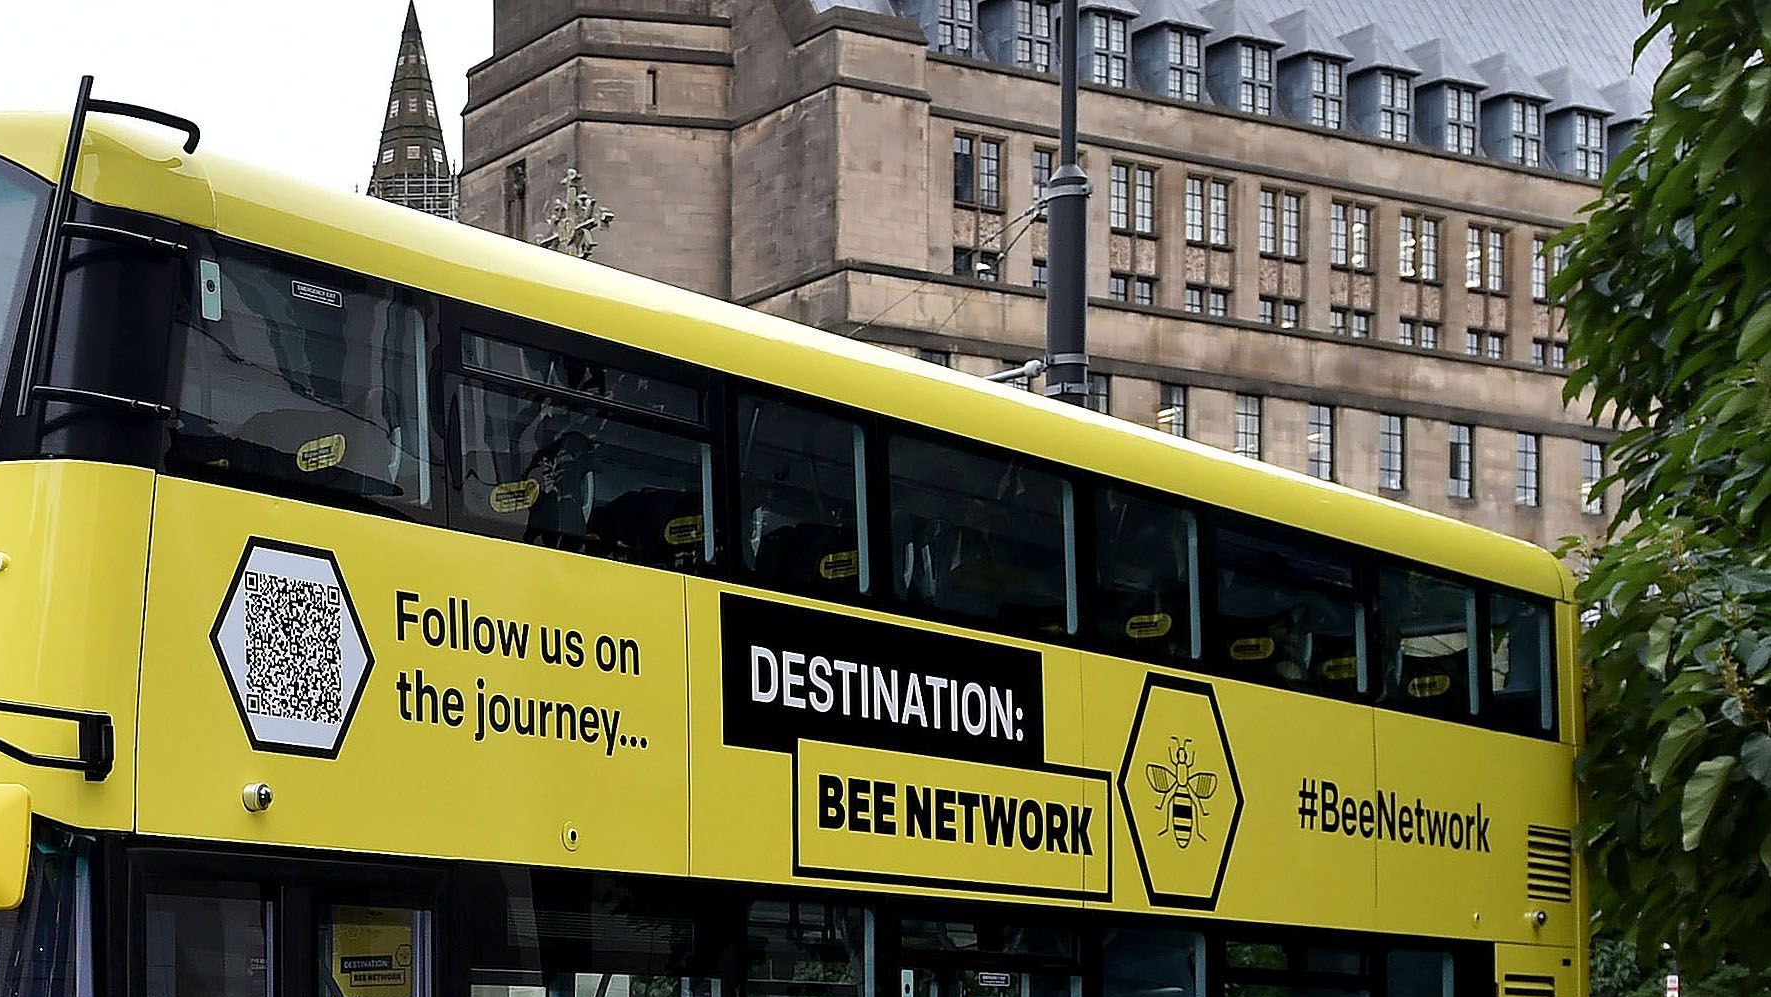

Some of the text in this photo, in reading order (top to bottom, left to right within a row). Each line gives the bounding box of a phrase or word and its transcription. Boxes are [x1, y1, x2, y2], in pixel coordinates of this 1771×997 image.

[395, 590, 640, 676] Follow us on
[396, 669, 649, 757] the journey...
[751, 645, 1024, 742] DESTINATION:
[818, 774, 1094, 857] BEE NETWORK
[1298, 777, 1491, 853] #BeeNetwork
